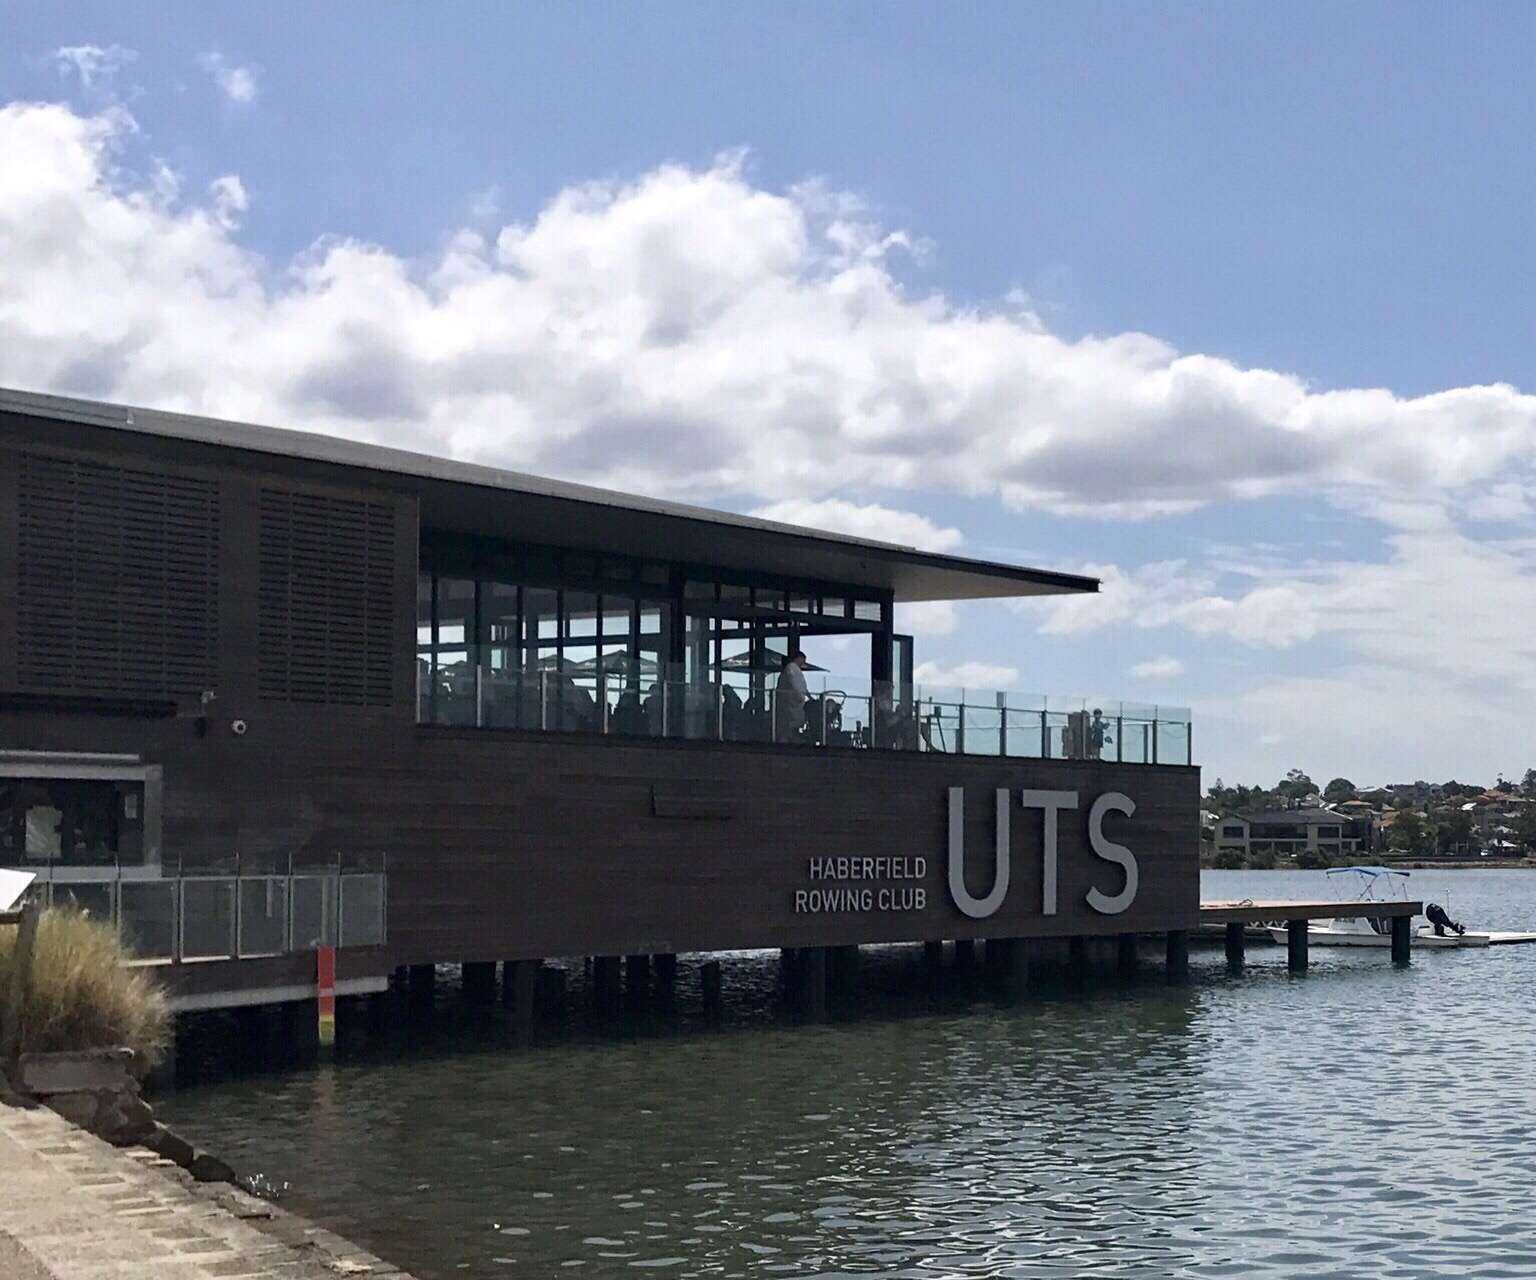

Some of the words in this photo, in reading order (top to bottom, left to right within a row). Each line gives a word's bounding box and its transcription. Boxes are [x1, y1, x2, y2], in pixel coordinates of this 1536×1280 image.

[948, 786, 1139, 918] UTS
[810, 857, 927, 880] HABERFIELD
[796, 889, 873, 912] ROWING
[878, 888, 926, 910] CLUB
